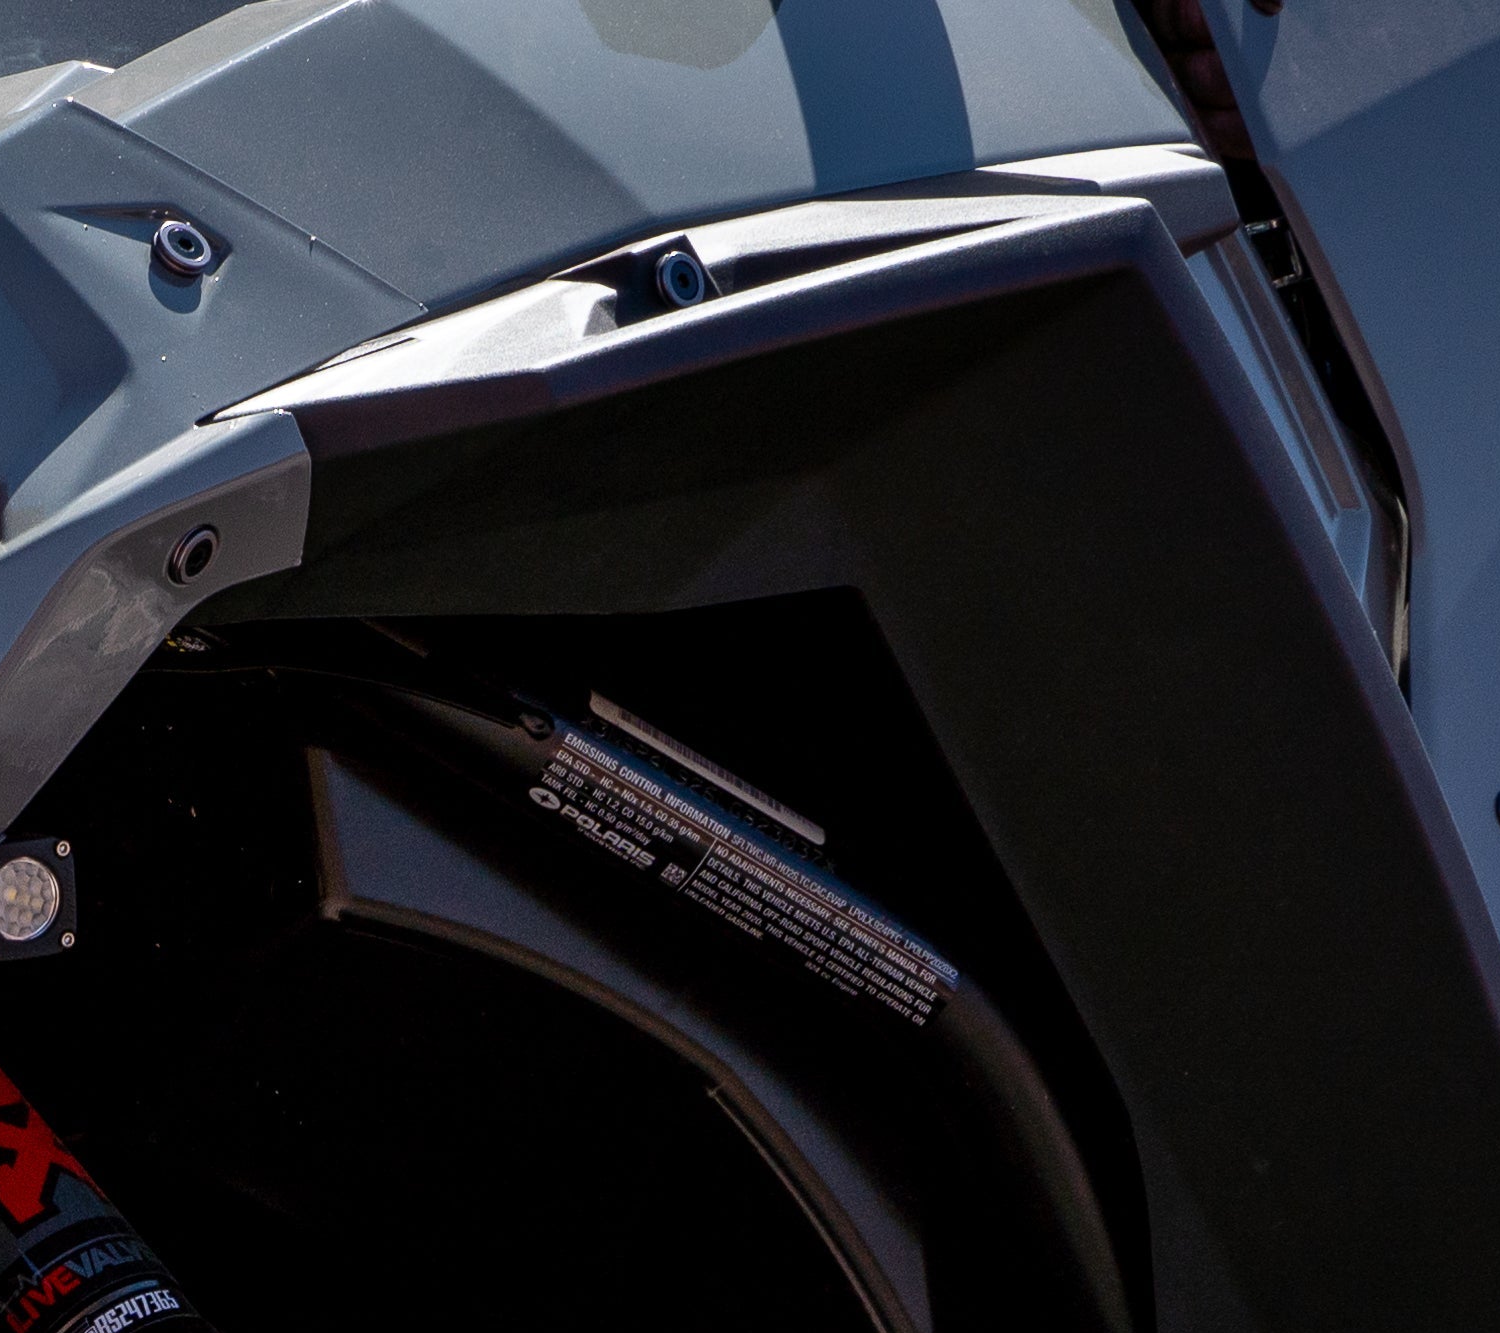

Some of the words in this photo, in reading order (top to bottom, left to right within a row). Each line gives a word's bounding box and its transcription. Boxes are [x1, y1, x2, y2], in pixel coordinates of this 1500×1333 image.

[539, 773, 564, 792] TANK
[561, 786, 579, 801] FEL
[583, 799, 598, 813] HC
[555, 749, 574, 766] EPA
[571, 759, 591, 776] STD
[598, 775, 614, 790] HC
[619, 788, 640, 805] NOx
[654, 808, 668, 822] CO
[677, 823, 702, 844] g/km
[559, 802, 656, 867] POLARIS
[563, 732, 620, 772] EMISSIONS
[617, 764, 665, 800] CONTROL
[663, 792, 732, 840] INFORMATION
[565, 772, 585, 789] STD
[591, 787, 606, 802] HC
[620, 805, 635, 819] CO
[650, 824, 675, 845] g/km
[690, 878, 720, 900] MODEL
[719, 895, 742, 914] YEAR
[763, 922, 784, 939] THIS
[782, 933, 816, 958] VEHICLE
[814, 953, 826, 965] IS
[824, 959, 865, 988] CERTIFIED
[864, 983, 877, 996] TO
[875, 990, 913, 1018] OPERATE
[911, 1012, 927, 1027] ON
[698, 868, 718, 885] AND
[716, 879, 763, 912] CALIFORNIA
[761, 906, 803, 936] OFF-ROAD
[801, 930, 830, 953] SPORT
[828, 946, 862, 972] VEHICLE
[860, 966, 915, 1004] REGULATIONS
[912, 998, 932, 1015] FOR
[713, 844, 729, 859] NO
[727, 852, 786, 893] ADJUSTMENTS
[784, 886, 833, 922] NECESSARY.
[832, 915, 850, 932] SEE
[848, 925, 887, 954] OWNER'S
[885, 947, 921, 974] MANUAL
[918, 968, 937, 985] FOR
[741, 878, 762, 896] THIS
[760, 889, 793, 915] VEHICLE
[792, 908, 822, 932] MEETS
[820, 925, 837, 941] U.S.
[837, 935, 856, 952] EPA
[853, 945, 905, 982] ALL-TERRAIN
[903, 976, 938, 1002] VEHICLE
